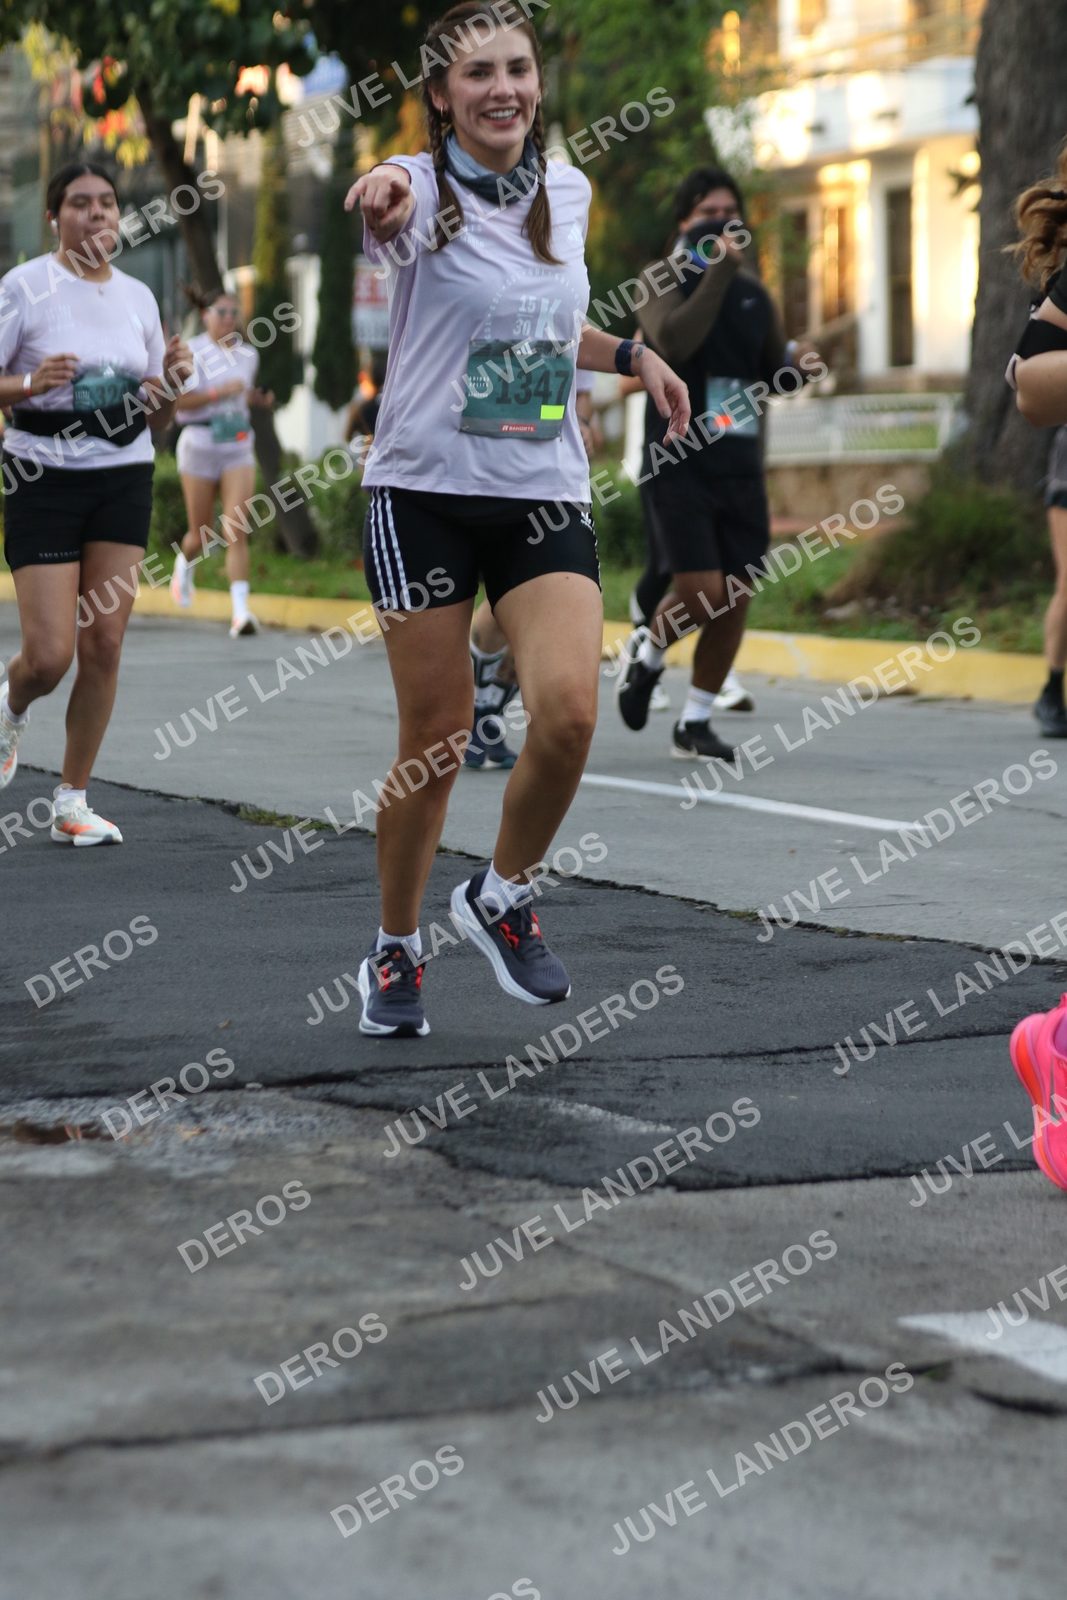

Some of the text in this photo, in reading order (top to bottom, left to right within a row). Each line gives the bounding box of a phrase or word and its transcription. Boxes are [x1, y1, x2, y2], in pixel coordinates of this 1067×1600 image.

[518, 294, 537, 313] 15
[534, 297, 562, 338] K
[513, 318, 532, 336] 30
[495, 369, 570, 406] 1347
